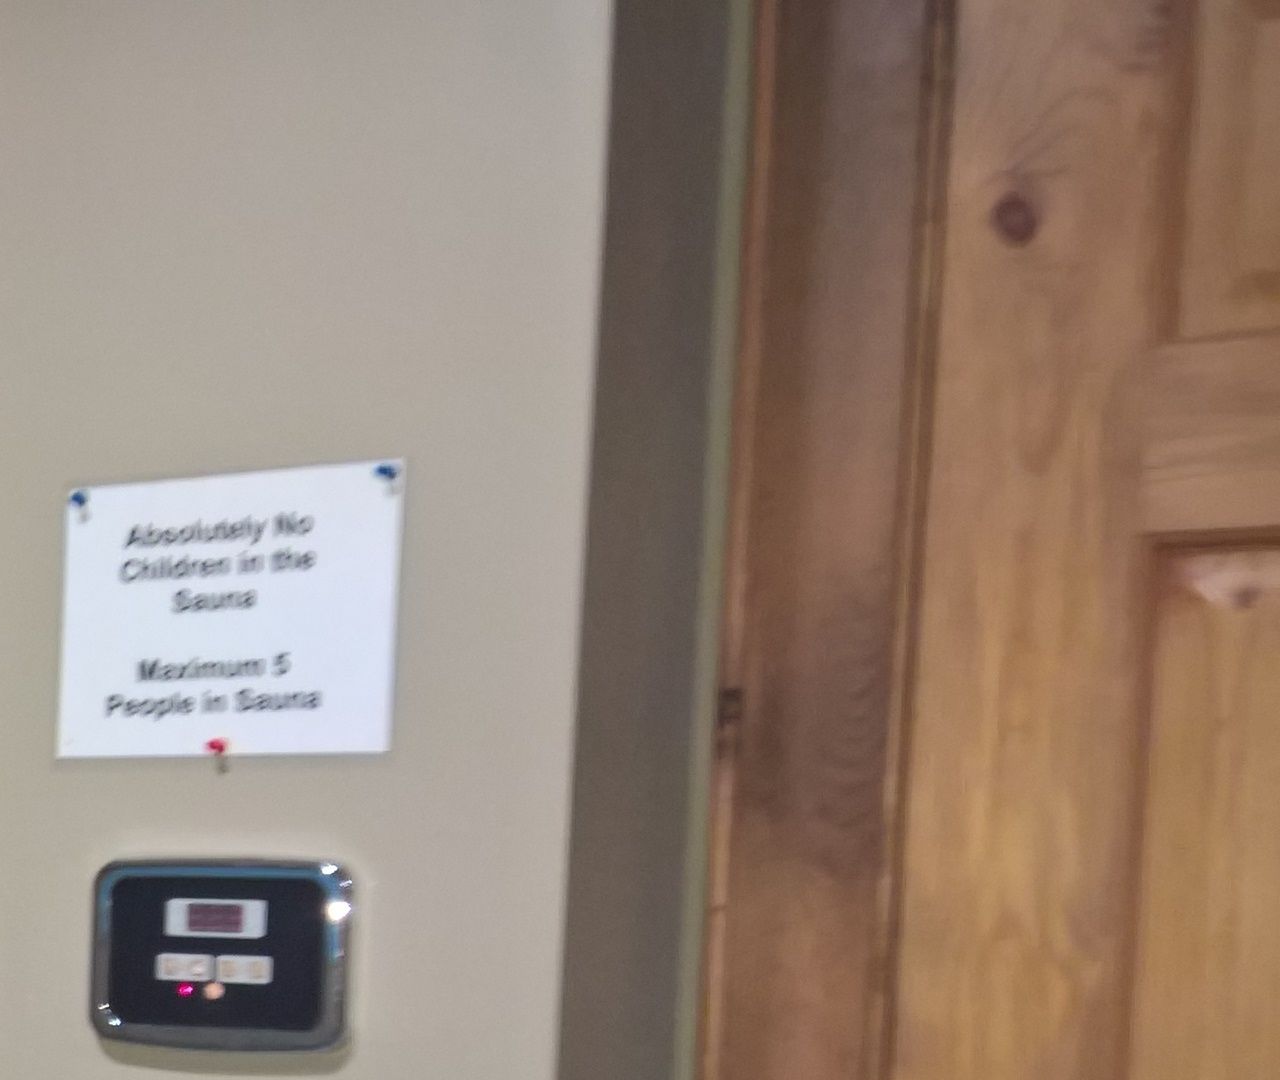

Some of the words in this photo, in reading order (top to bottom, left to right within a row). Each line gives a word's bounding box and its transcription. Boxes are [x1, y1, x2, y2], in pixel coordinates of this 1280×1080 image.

[124, 518, 266, 549] Absolutely
[272, 511, 315, 537] No
[119, 553, 231, 584] Children
[237, 551, 265, 576] in
[270, 547, 317, 573] the
[171, 588, 258, 614] Sauna
[136, 656, 266, 682] Maximum
[272, 651, 292, 678] 5
[105, 692, 195, 721] People
[201, 690, 229, 714] in
[234, 687, 323, 714] Sauna
